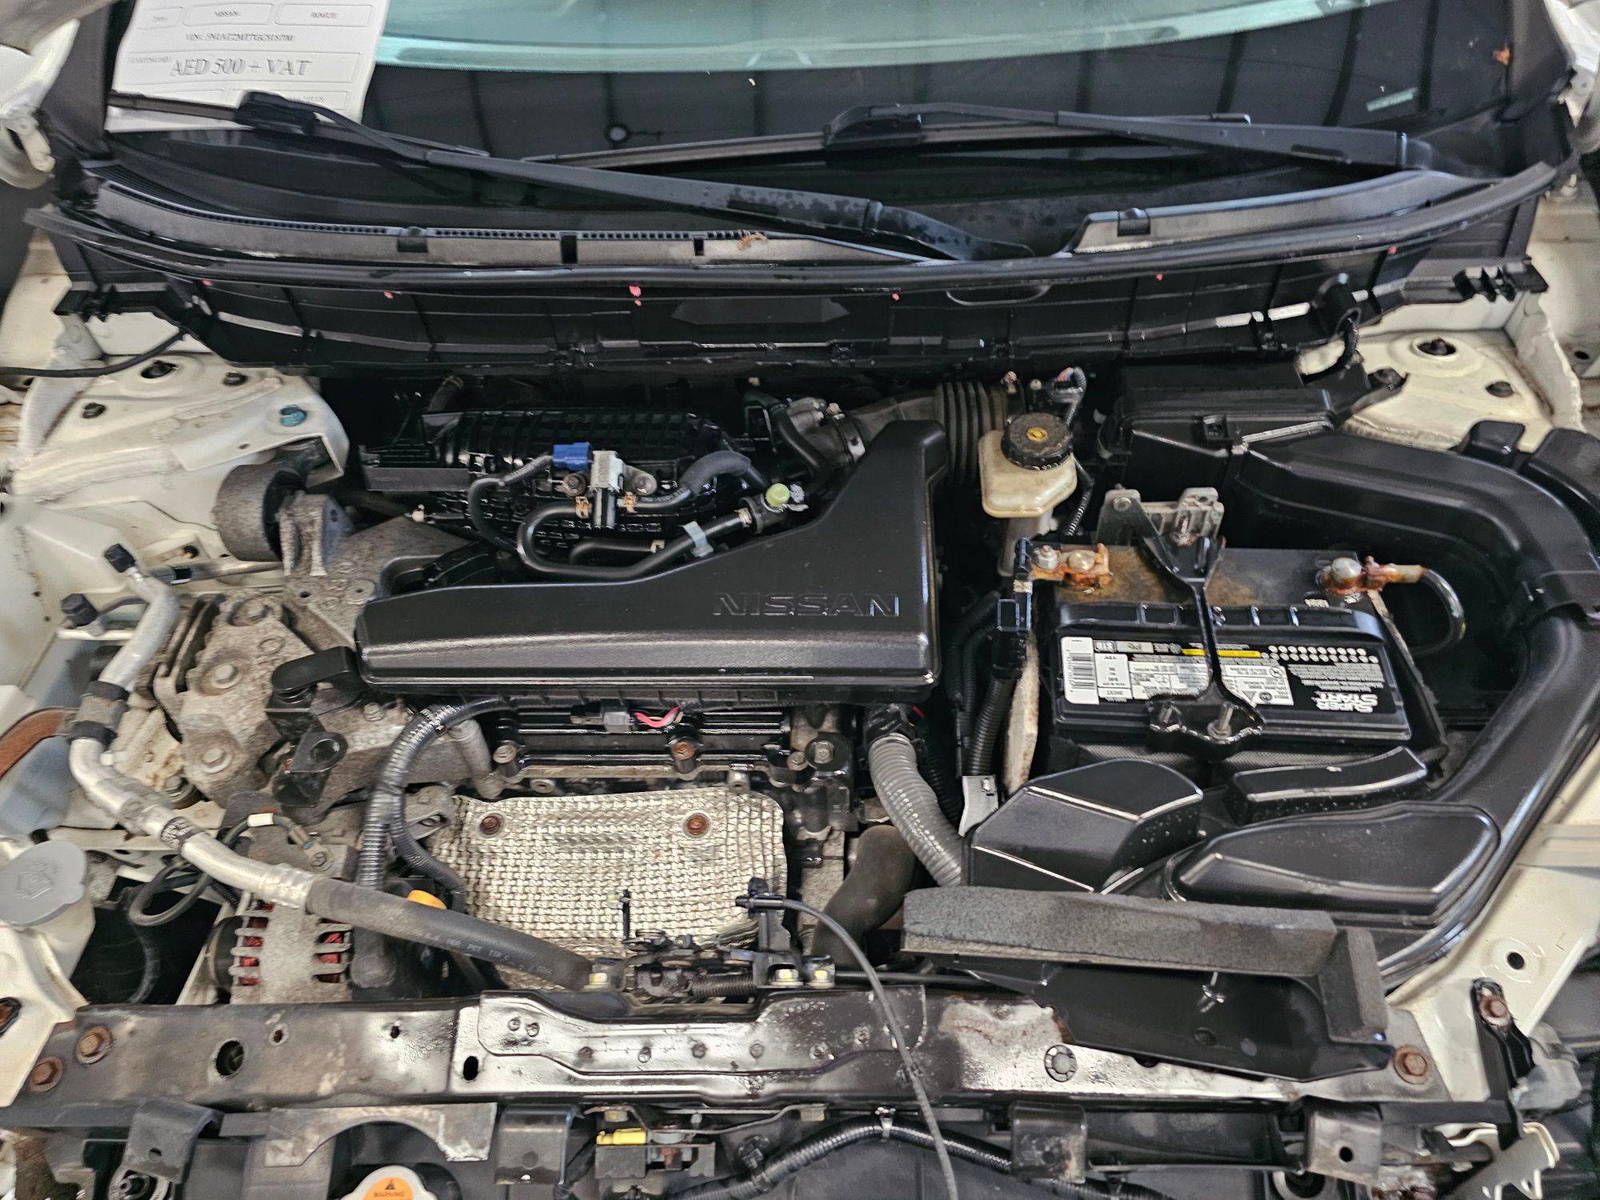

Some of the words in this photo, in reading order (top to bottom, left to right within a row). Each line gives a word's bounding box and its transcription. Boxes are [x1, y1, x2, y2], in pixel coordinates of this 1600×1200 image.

[171, 59, 209, 76] AED
[213, 58, 243, 75] 500
[267, 58, 312, 76] VAT
[713, 592, 900, 617] NISSAN
[1315, 694, 1379, 706] START
[1316, 702, 1374, 713] SUPER
